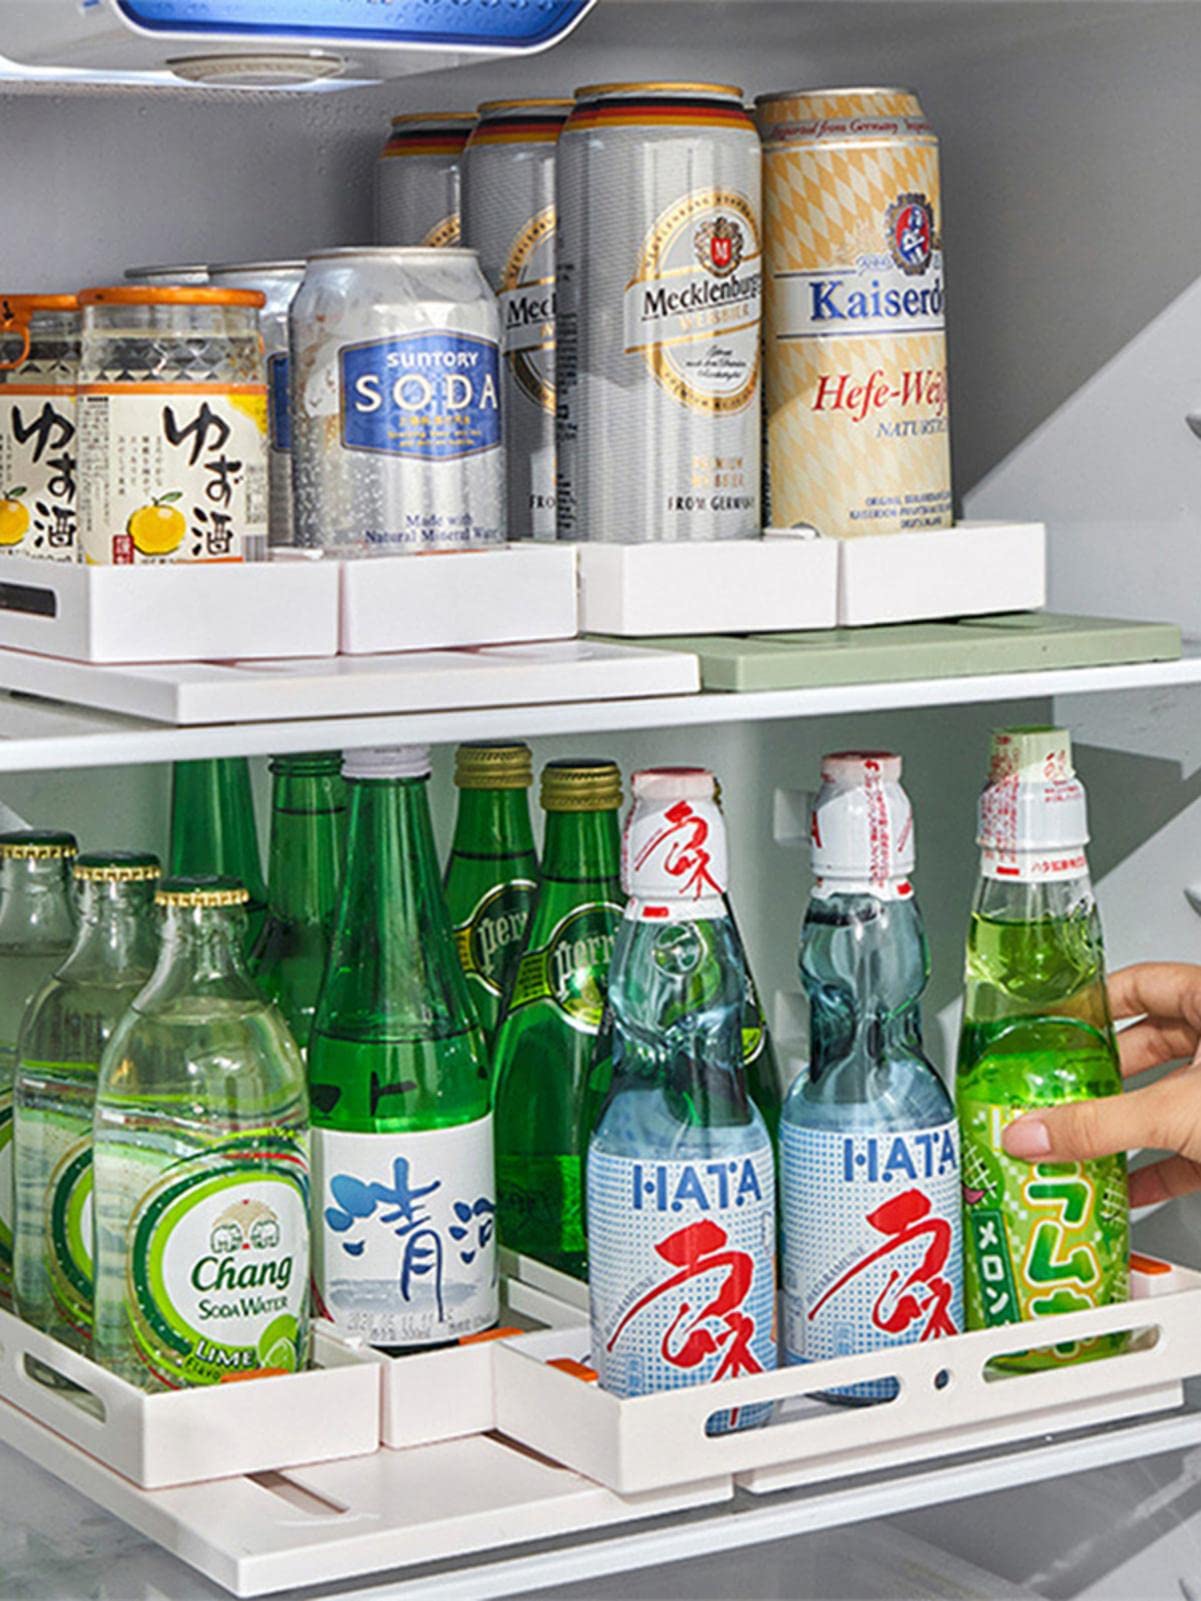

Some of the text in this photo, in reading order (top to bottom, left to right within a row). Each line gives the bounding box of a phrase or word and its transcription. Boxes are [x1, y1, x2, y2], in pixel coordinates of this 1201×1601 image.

[355, 374, 499, 413] SODA
[164, 401, 243, 557] ゆず酒
[529, 495, 557, 509] FRO
[844, 1129, 957, 1183] HATA
[631, 1158, 763, 1212] HATA
[191, 1256, 292, 1291] Chang
[978, 1220, 1011, 1322] メロン
[195, 1340, 253, 1367] LIME
